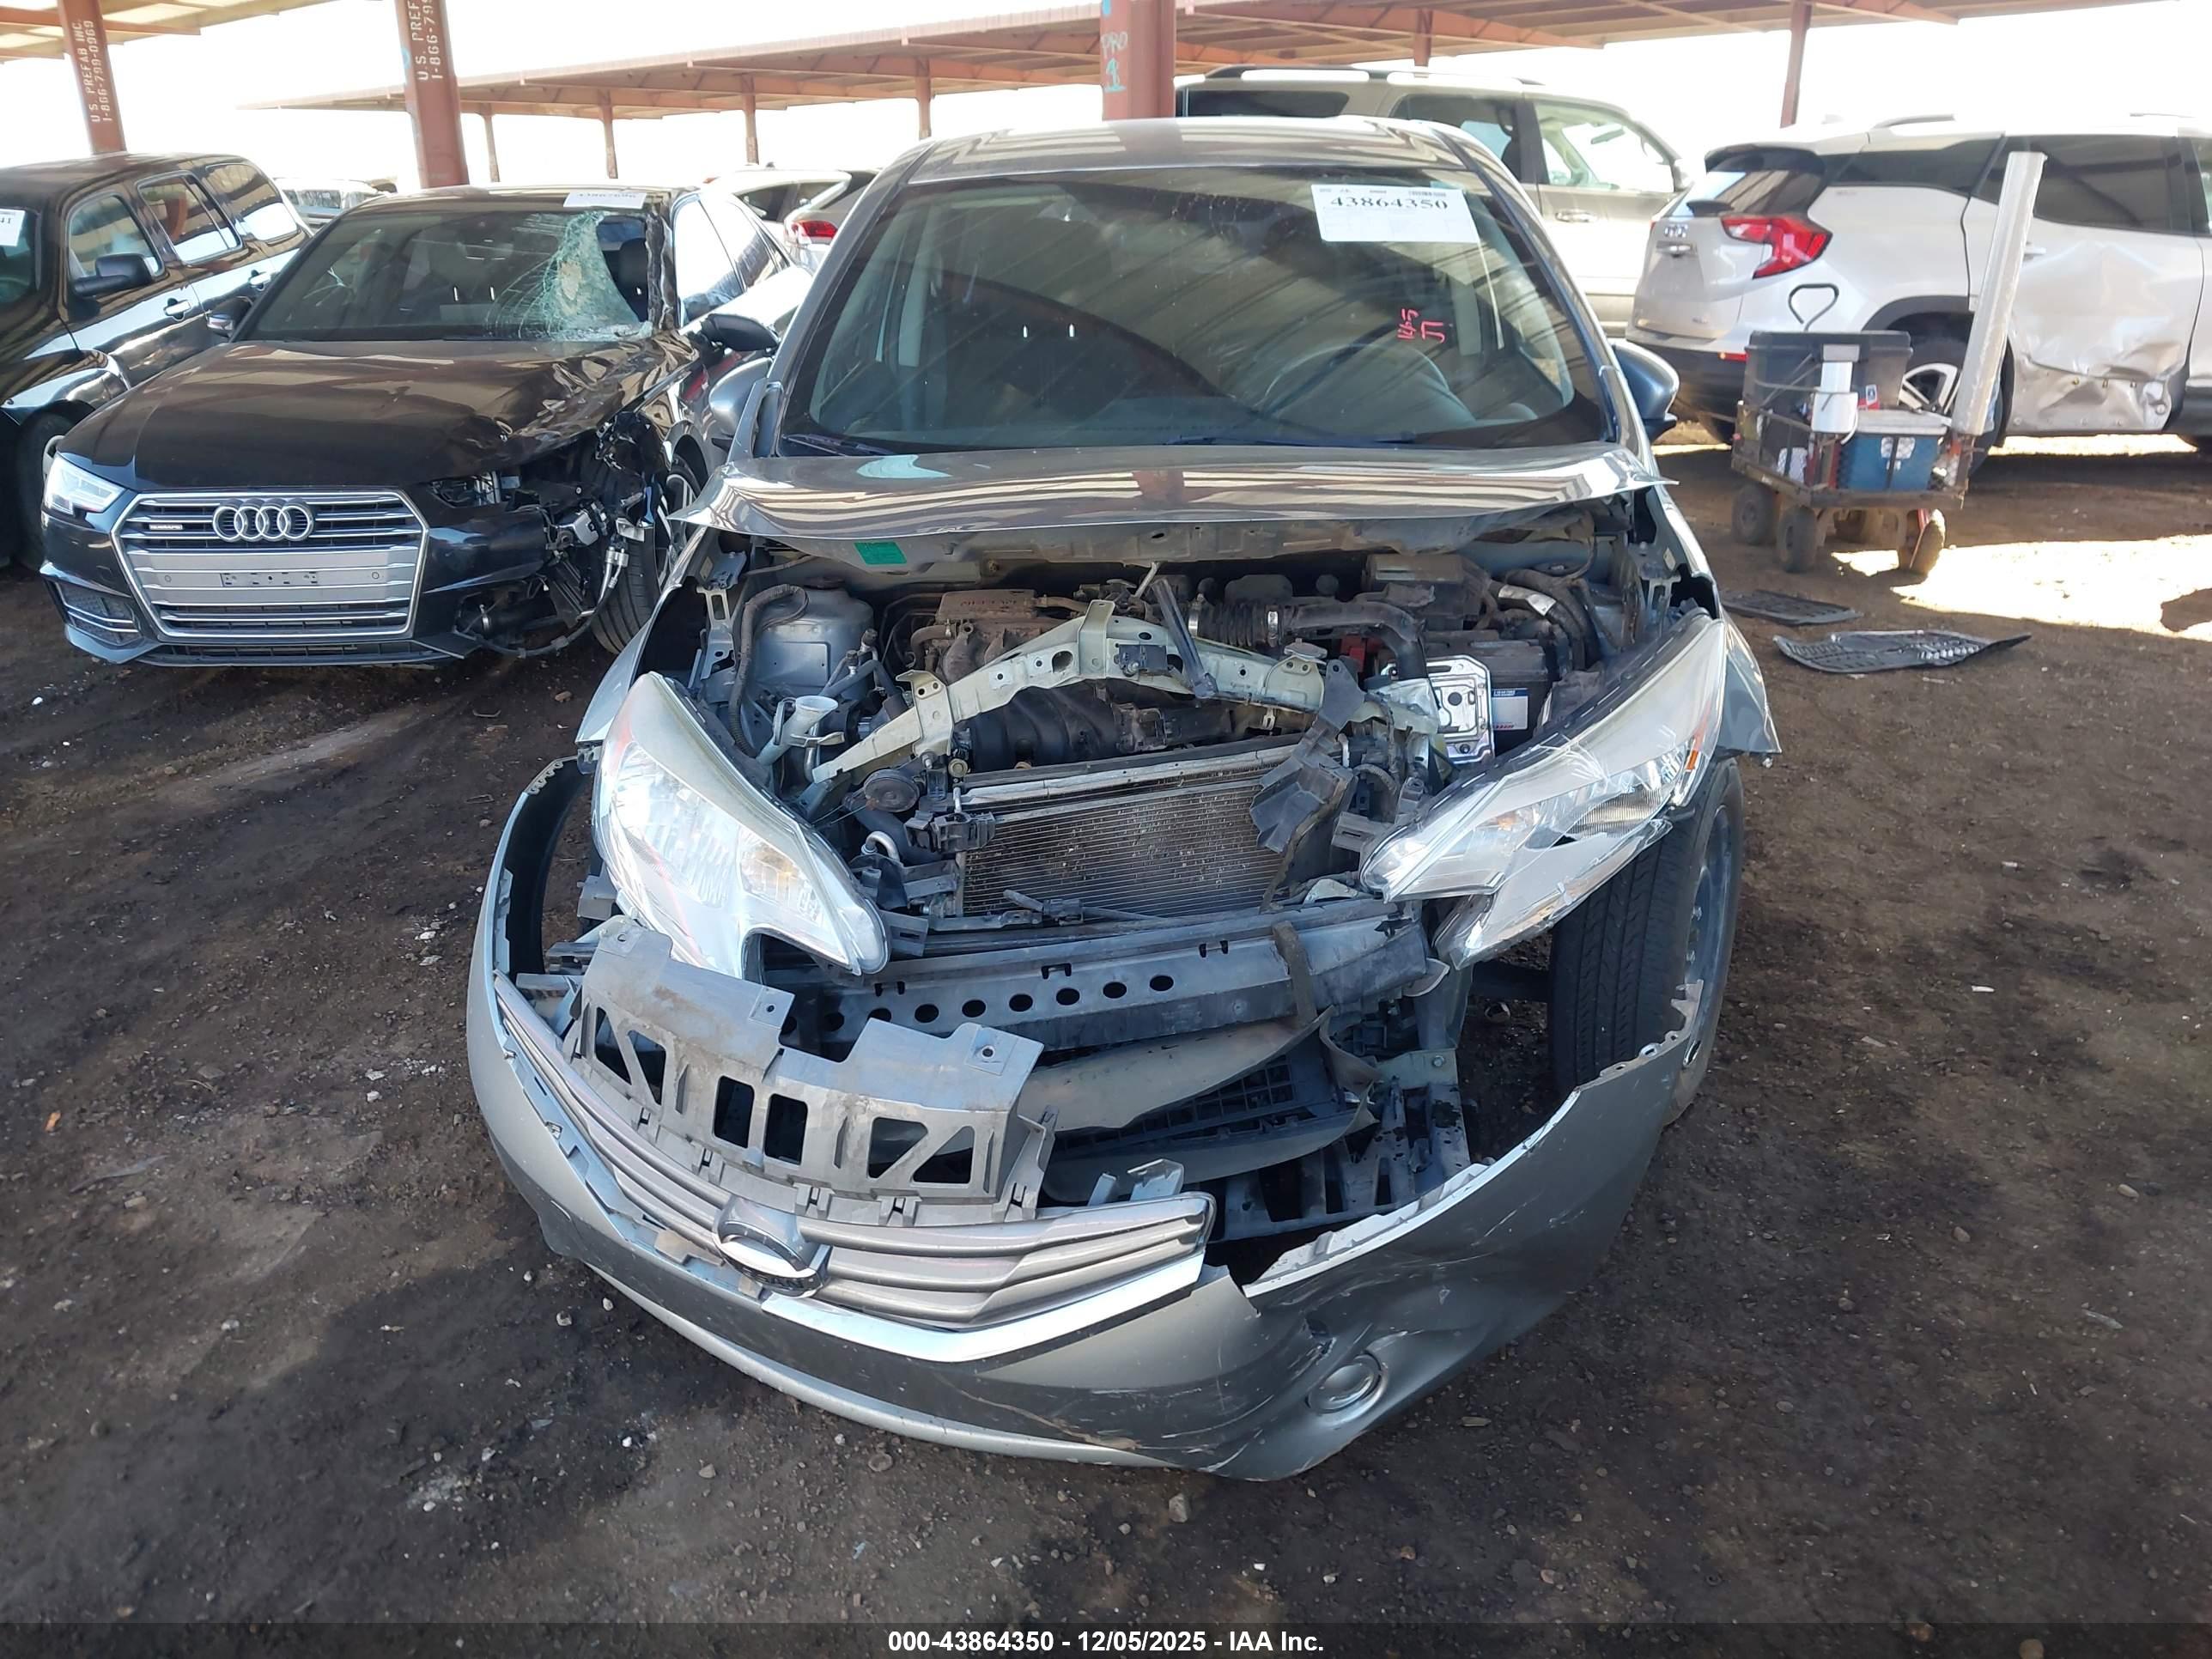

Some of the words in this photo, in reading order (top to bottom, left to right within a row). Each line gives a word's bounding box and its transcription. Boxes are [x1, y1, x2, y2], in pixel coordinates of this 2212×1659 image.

[422, 0, 444, 79] 1-866-79
[77, 47, 96, 94] PREFAB
[1330, 196, 1449, 210] 43864350
